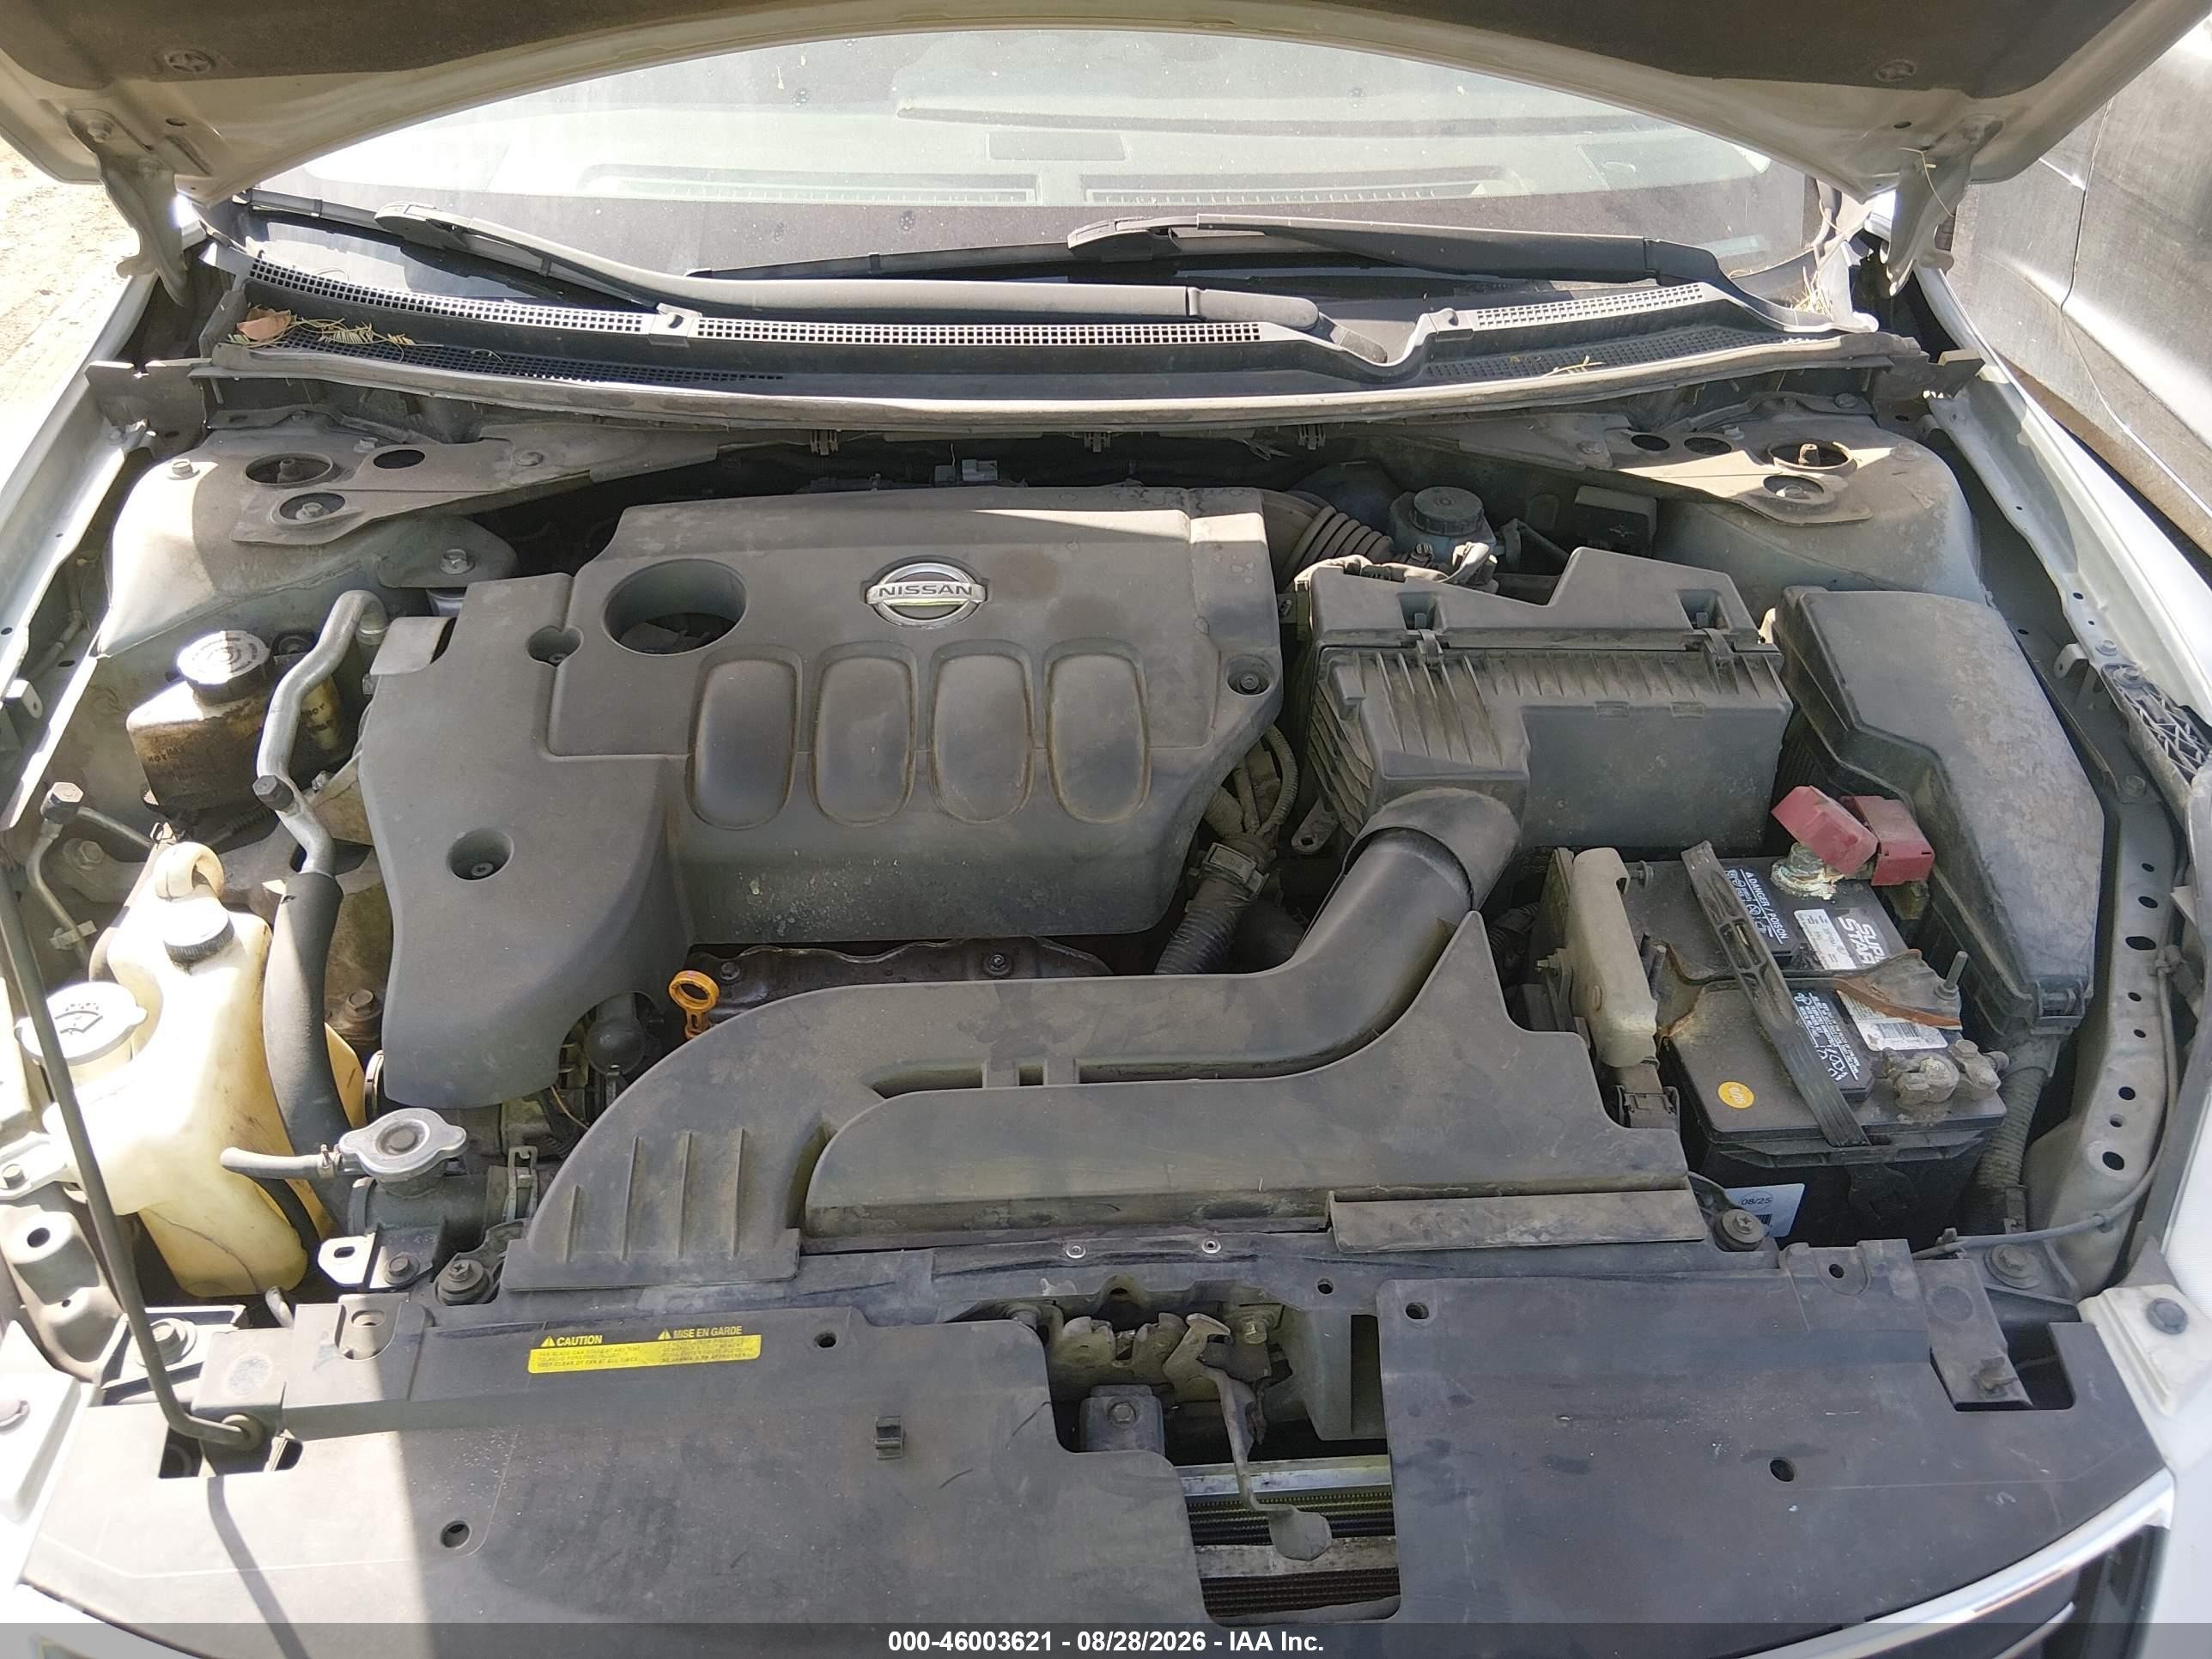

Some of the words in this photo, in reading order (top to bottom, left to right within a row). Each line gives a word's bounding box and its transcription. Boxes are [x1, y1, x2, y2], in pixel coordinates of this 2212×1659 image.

[878, 586, 973, 597] NISSAN
[1748, 878, 1771, 907] DANGER
[1767, 913, 1790, 939] POISON
[673, 1329, 695, 1339] MISE
[696, 1328, 710, 1337] EN
[710, 1326, 743, 1336] GARDE
[556, 1335, 603, 1346] CAUTION
